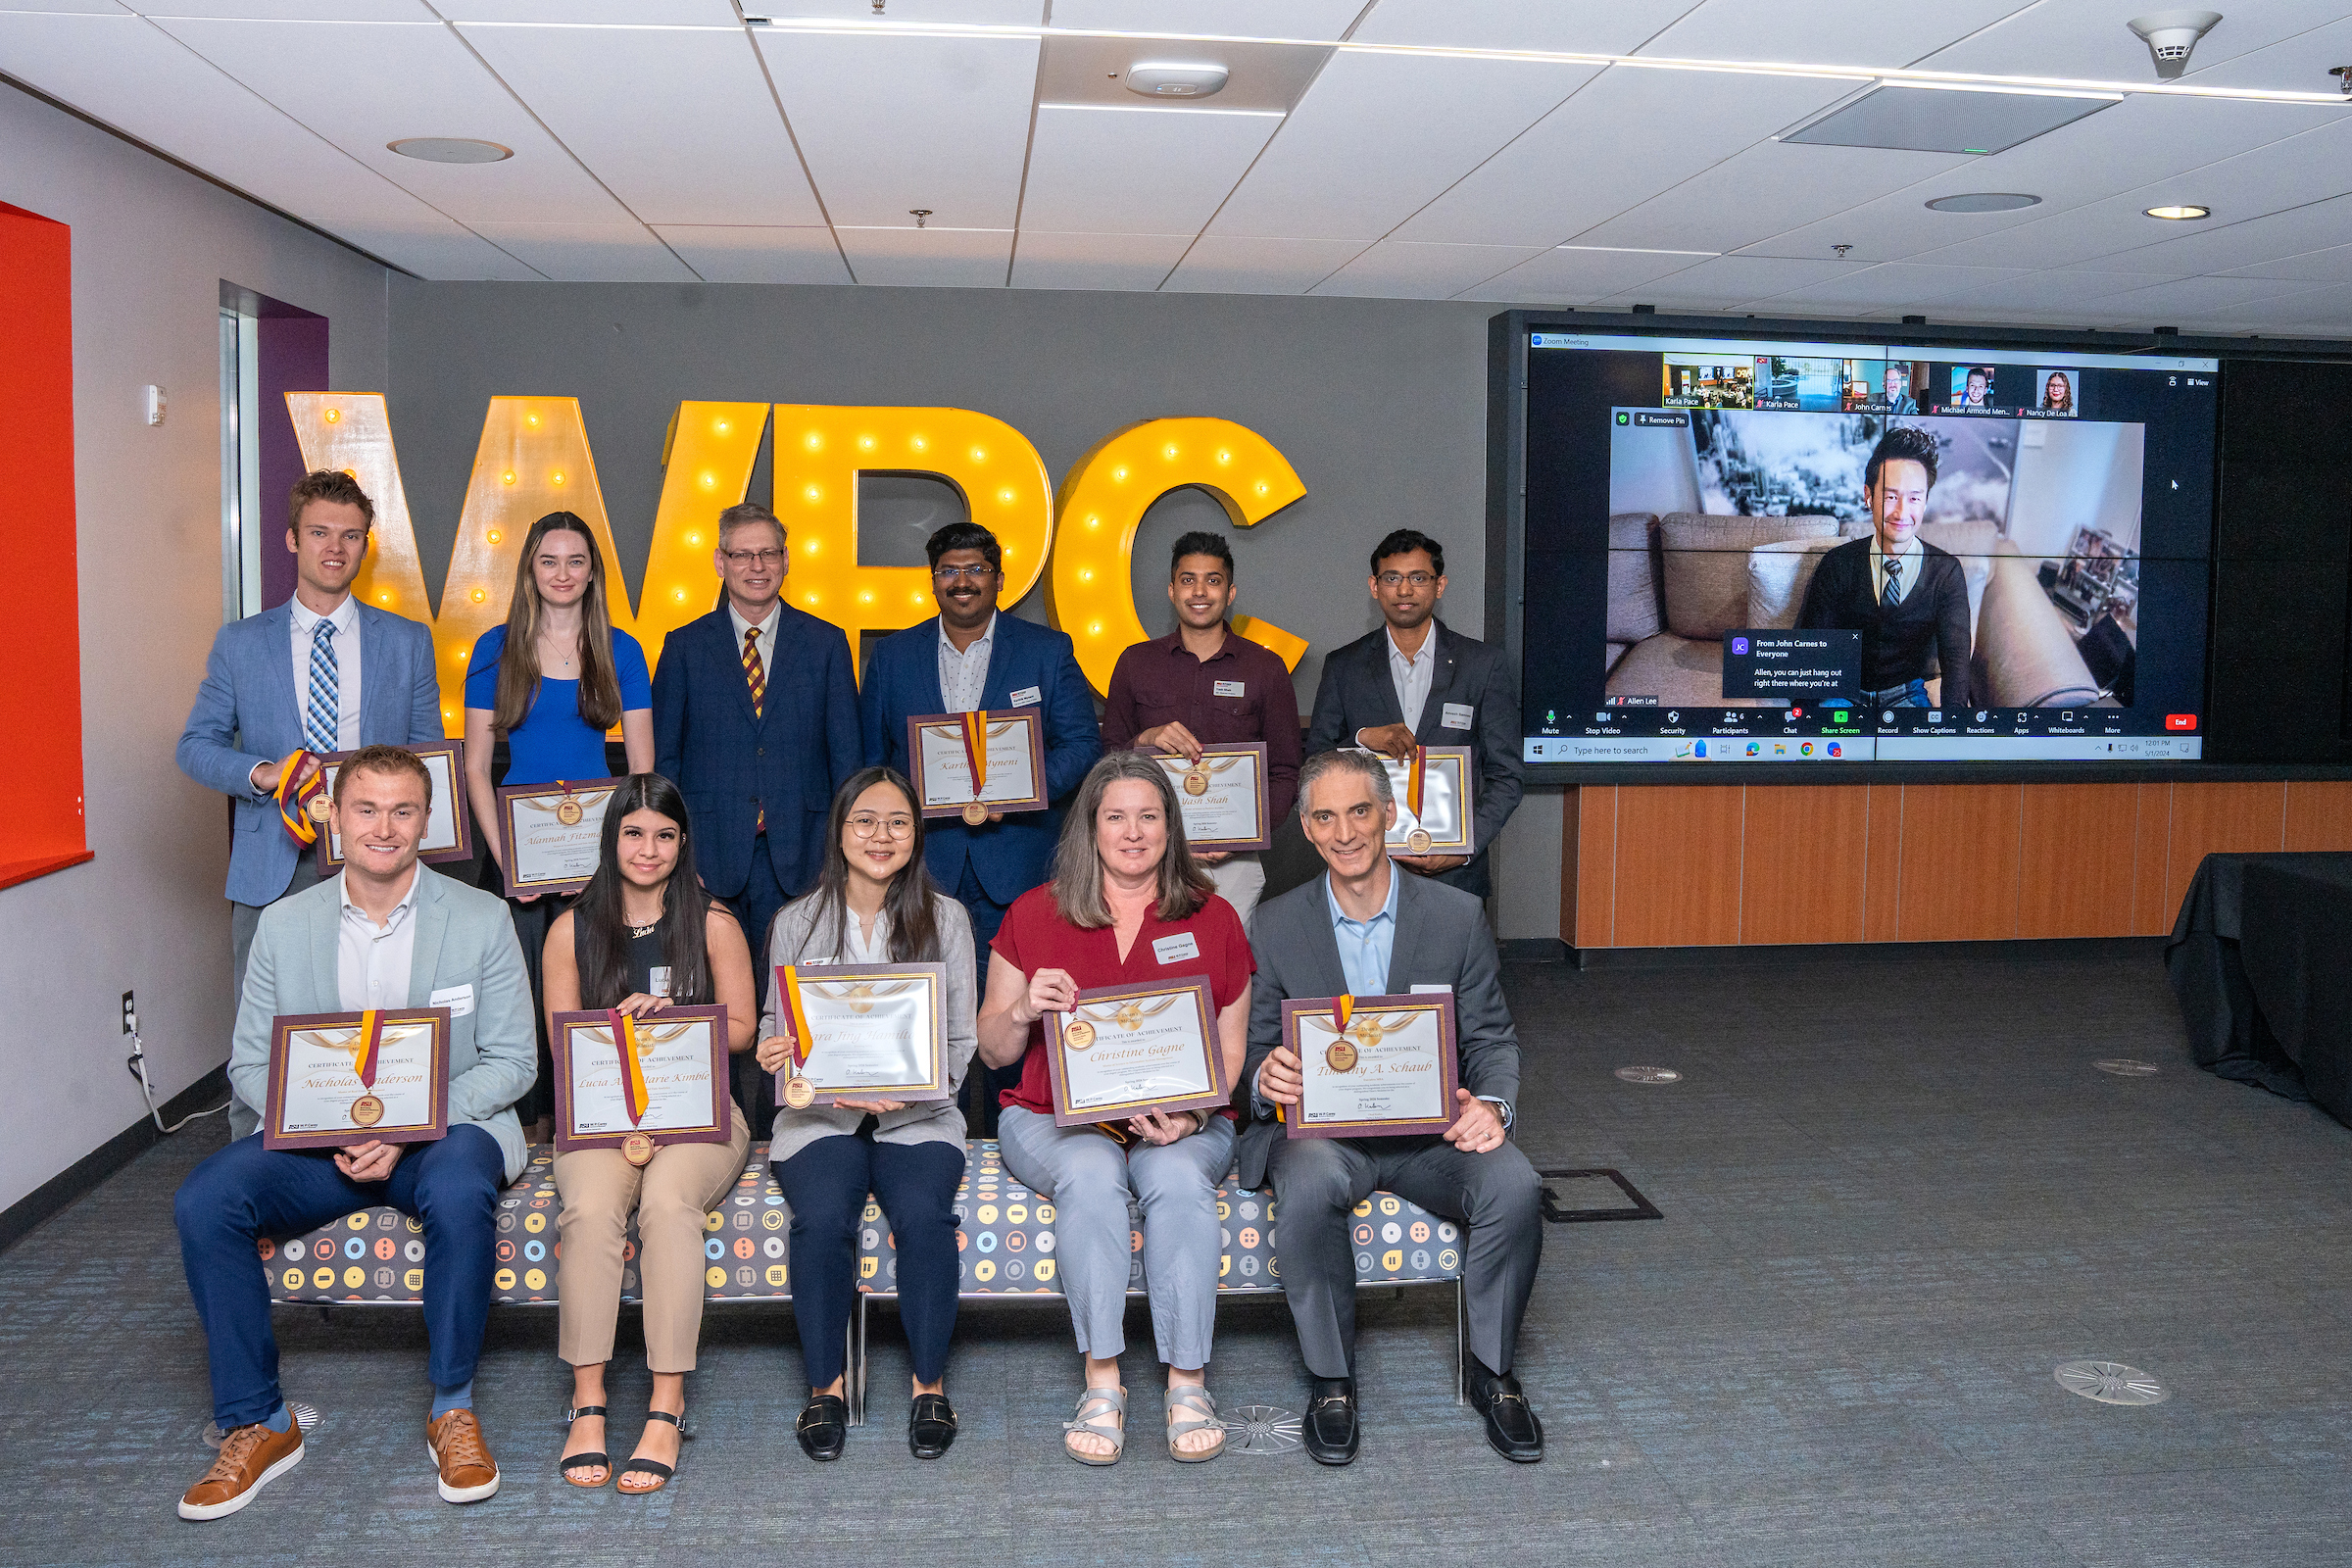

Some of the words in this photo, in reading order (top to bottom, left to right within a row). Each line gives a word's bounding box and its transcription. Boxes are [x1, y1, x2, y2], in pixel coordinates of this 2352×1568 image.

[1564, 339, 1589, 347] Meeting
[2027, 409, 2045, 418] Nancy
[285, 391, 1307, 739] WPC
[1756, 651, 1788, 659] Everyone
[1754, 669, 1773, 677] Allen,
[1799, 669, 1812, 677] just
[1813, 669, 1829, 678] hang
[1754, 679, 1770, 688] right
[1810, 680, 1829, 688] you're
[1574, 747, 1592, 755] Type
[940, 761, 969, 771] Karth
[1181, 796, 1203, 807] Yash
[1205, 795, 1229, 804] Shah
[524, 833, 566, 846] Alannah
[1137, 1026, 1182, 1036] ACHIEVEMENT
[812, 1033, 832, 1041] ara
[834, 1031, 861, 1044] Jing
[1090, 1047, 1144, 1063] Christine
[1148, 1042, 1184, 1056] Gagne
[1370, 1064, 1384, 1073] A.
[1388, 1060, 1433, 1073] Schaub
[302, 1077, 357, 1089] Nicholas
[362, 1073, 423, 1085] nderson
[578, 1078, 608, 1088] Lucia
[672, 1071, 710, 1082] Kimble
